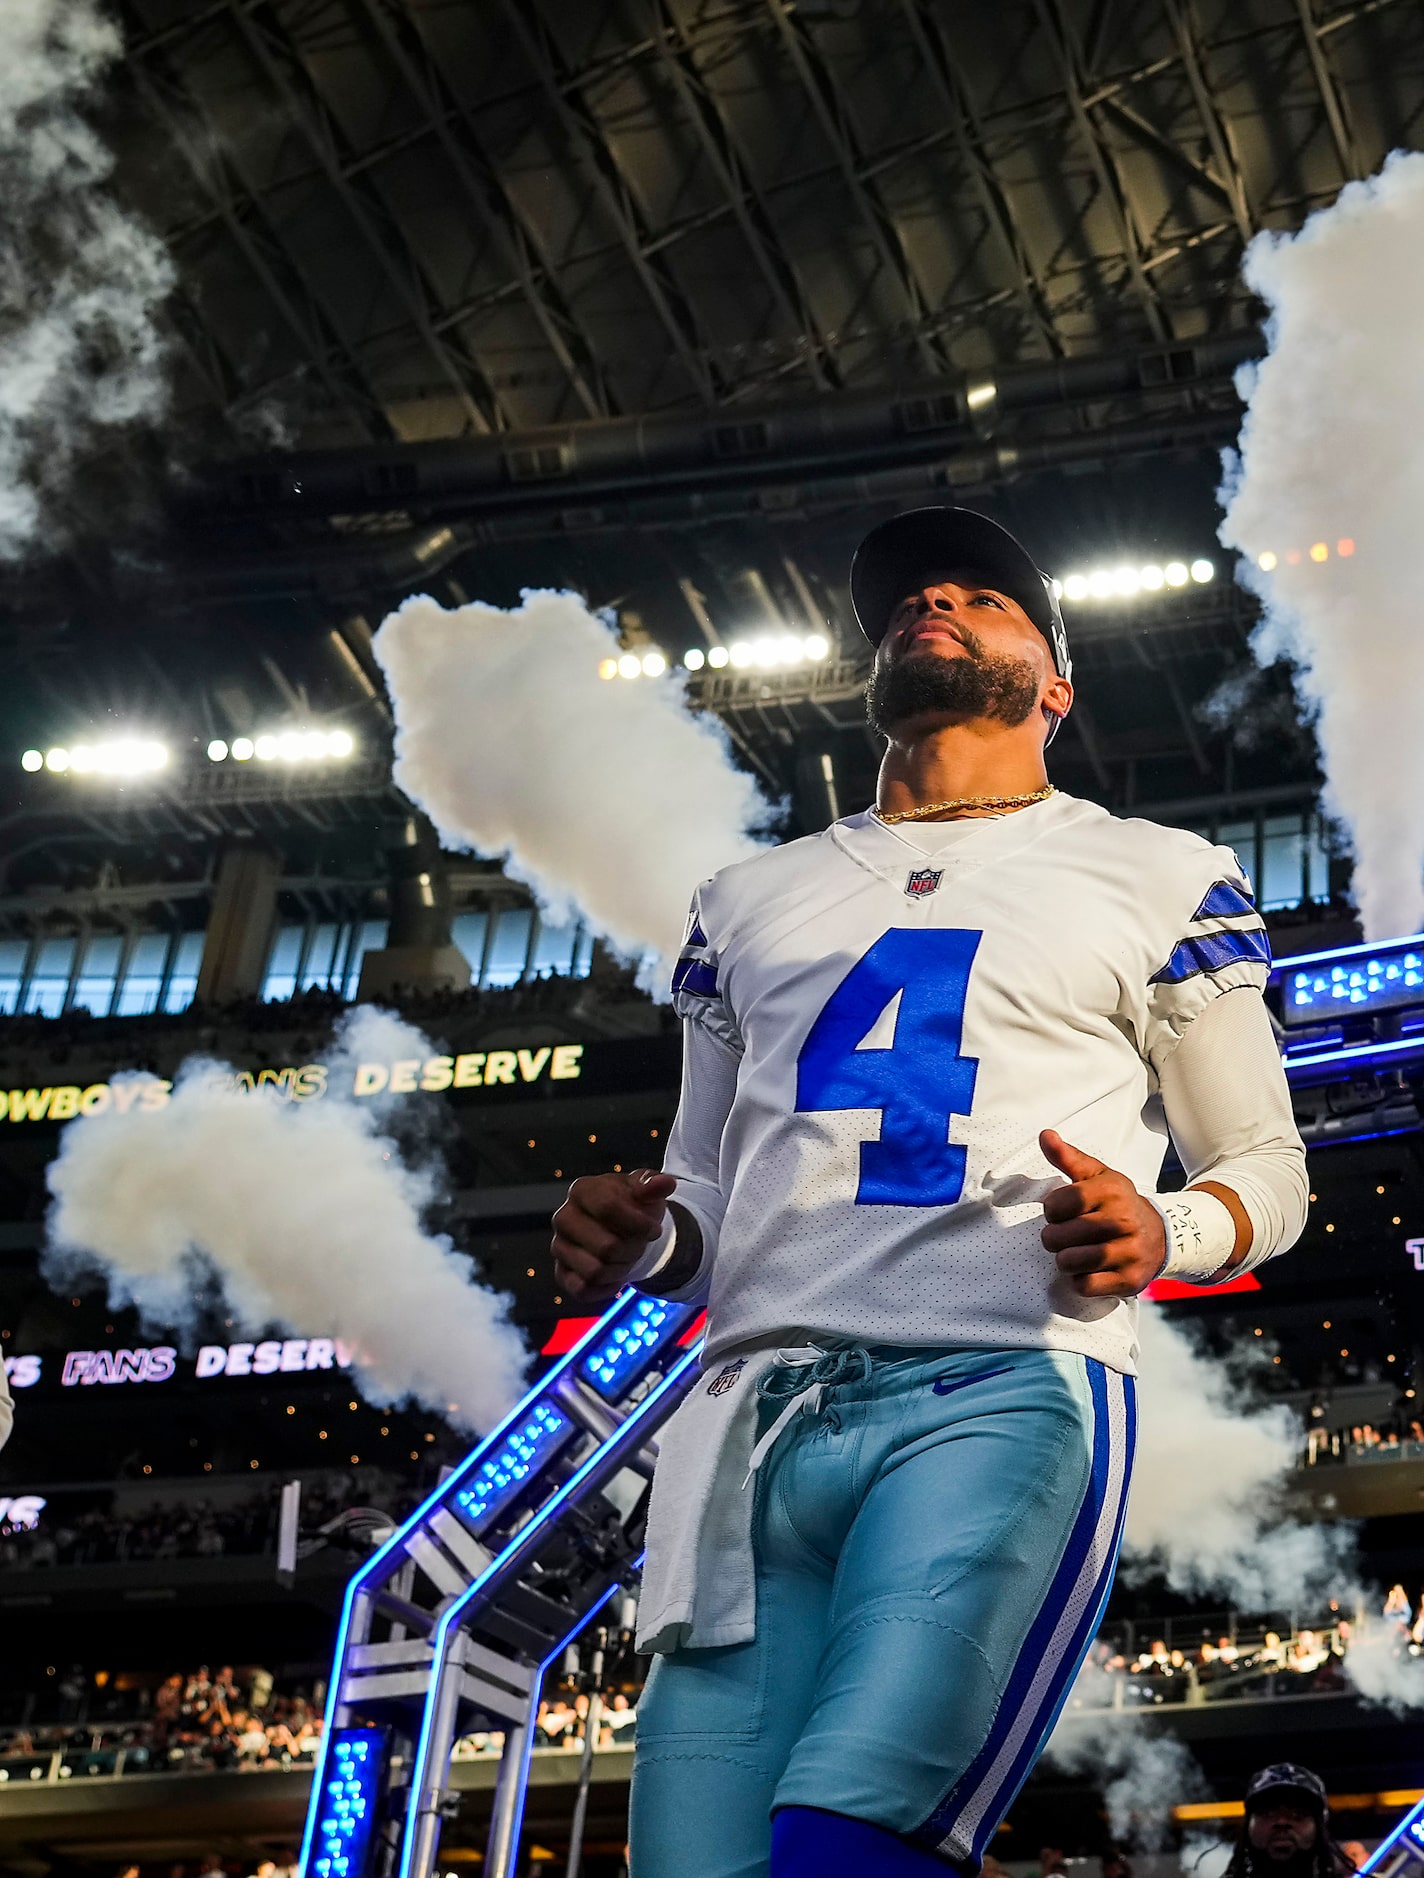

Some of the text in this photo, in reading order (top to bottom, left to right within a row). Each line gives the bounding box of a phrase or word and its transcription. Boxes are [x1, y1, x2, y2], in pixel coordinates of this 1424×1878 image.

[911, 879, 935, 892] NFL
[353, 1044, 584, 1097] DESERVE
[794, 926, 983, 1208] 4
[61, 1346, 177, 1387] FANS
[195, 1337, 361, 1379] DESERV
